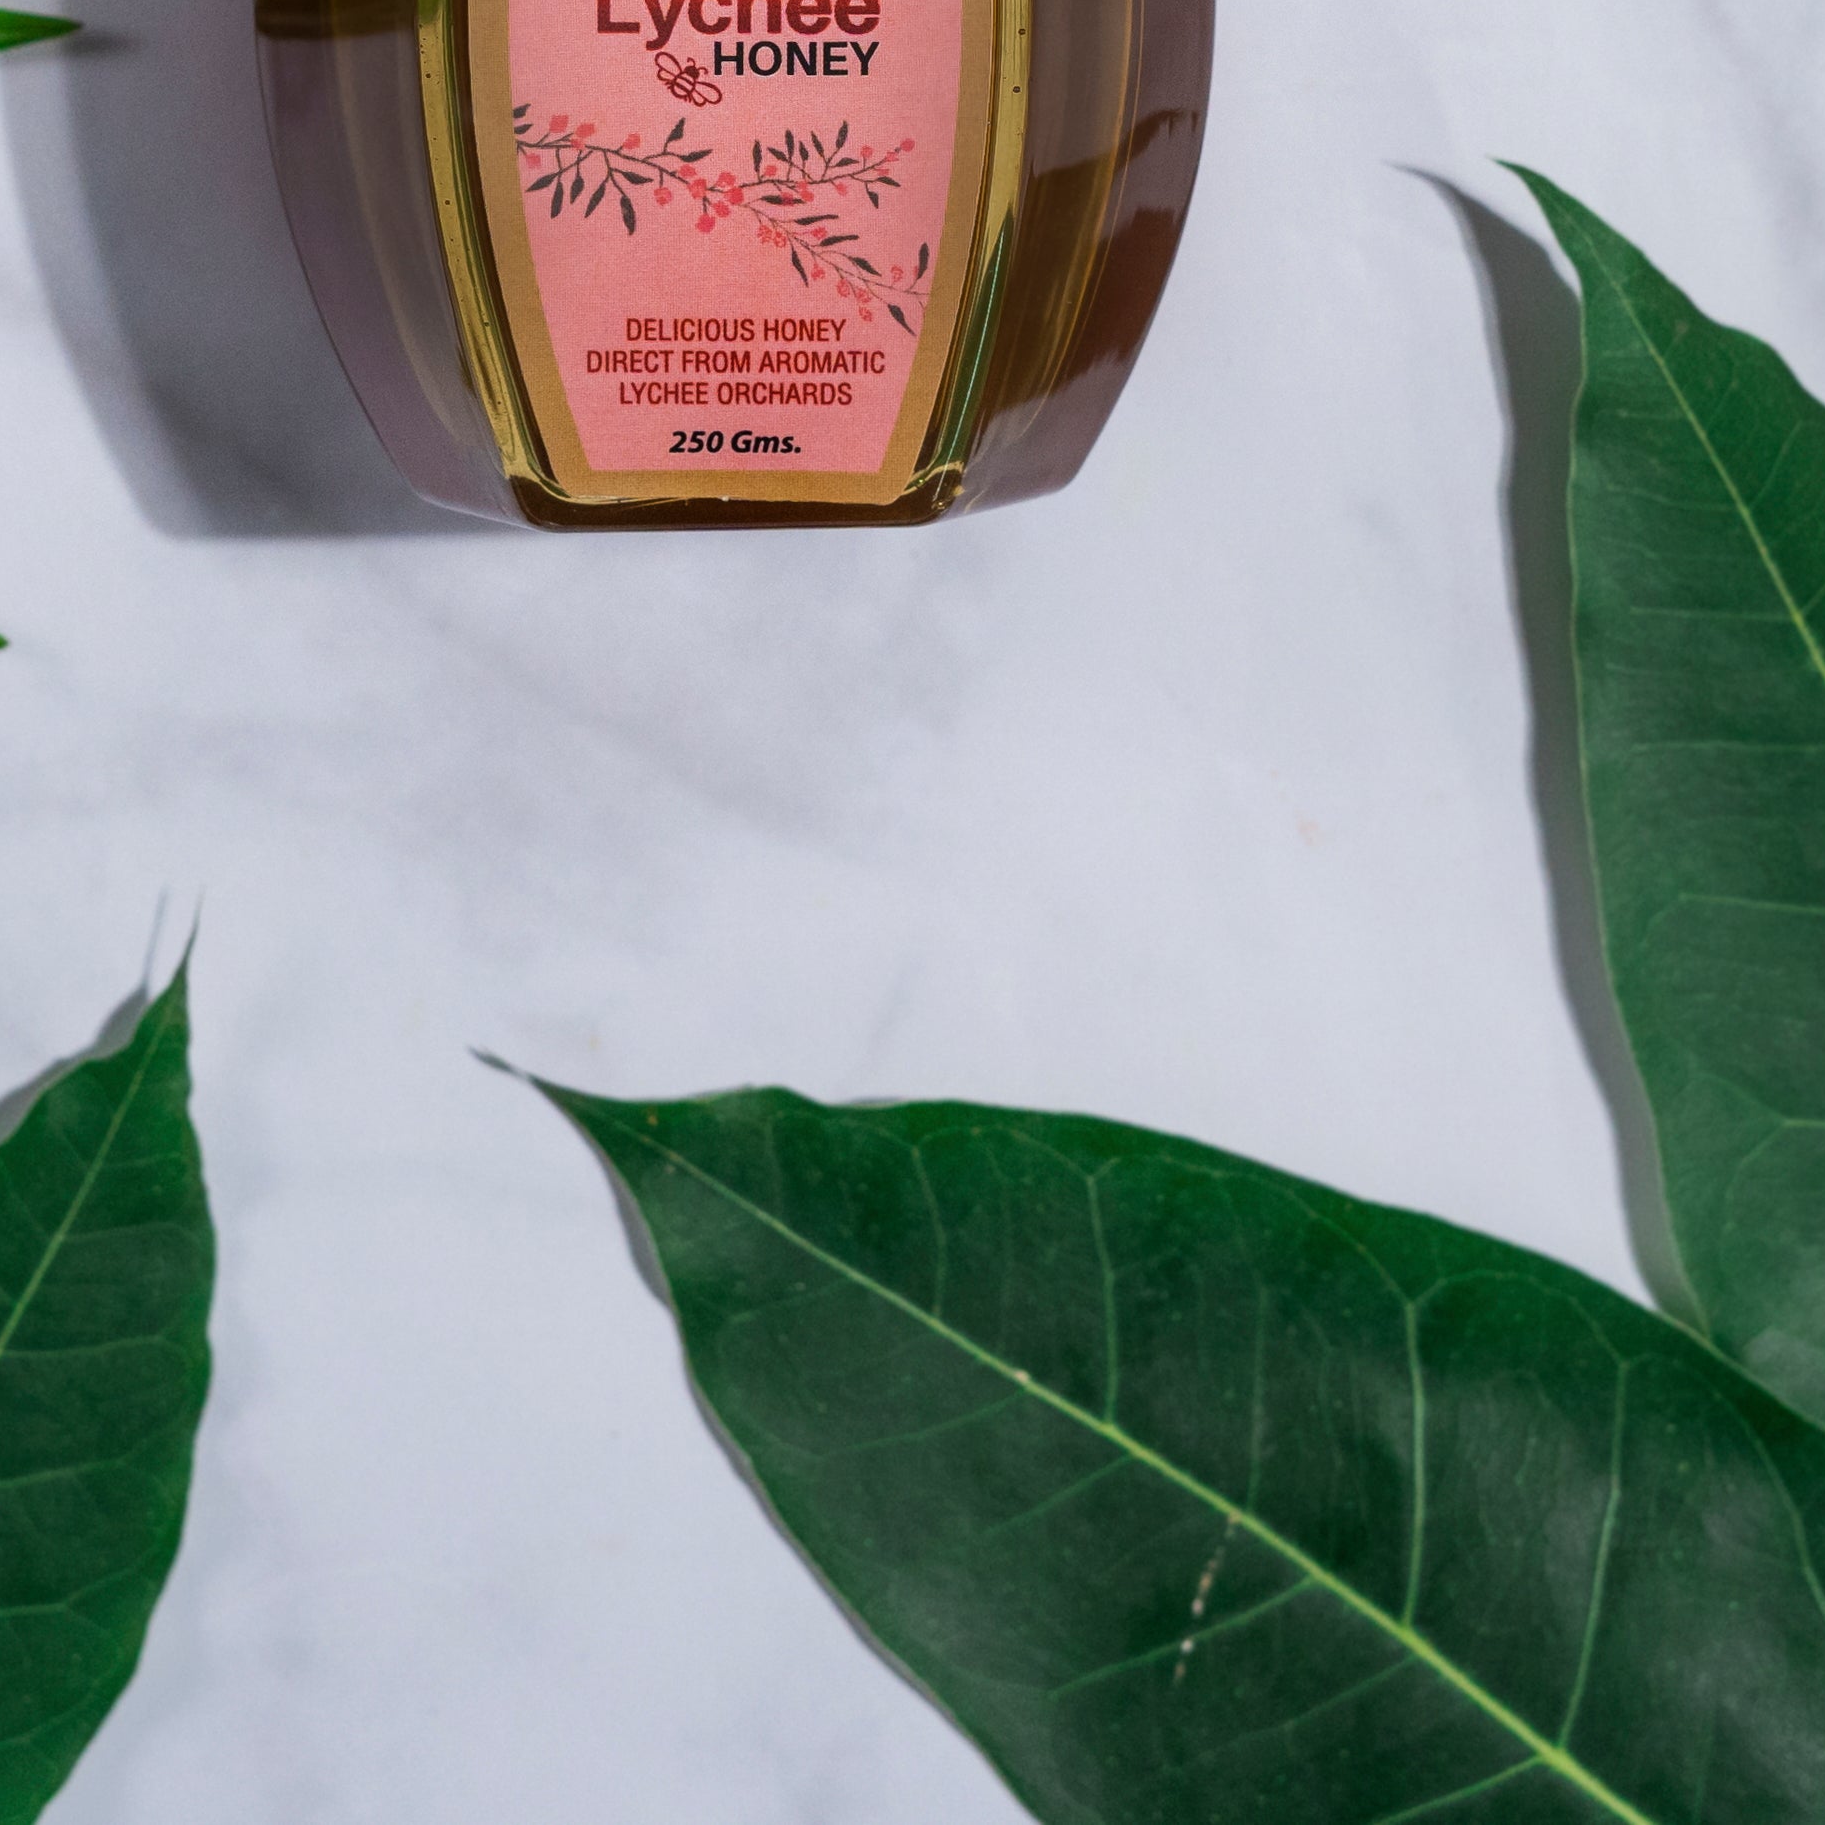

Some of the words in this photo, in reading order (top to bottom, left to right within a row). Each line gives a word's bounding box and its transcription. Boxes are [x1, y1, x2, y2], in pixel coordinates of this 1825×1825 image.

[713, 41, 880, 76] HONEY
[626, 318, 755, 342] DELICIOUS
[763, 318, 847, 342] HONEY
[586, 350, 674, 374] DIRECT
[681, 350, 751, 374] FROM
[758, 350, 886, 374] AROMATIC
[619, 382, 709, 405] LYCHEE
[717, 382, 853, 406] ORCHARDS
[668, 430, 725, 454] 250
[730, 430, 802, 454] Gms.
